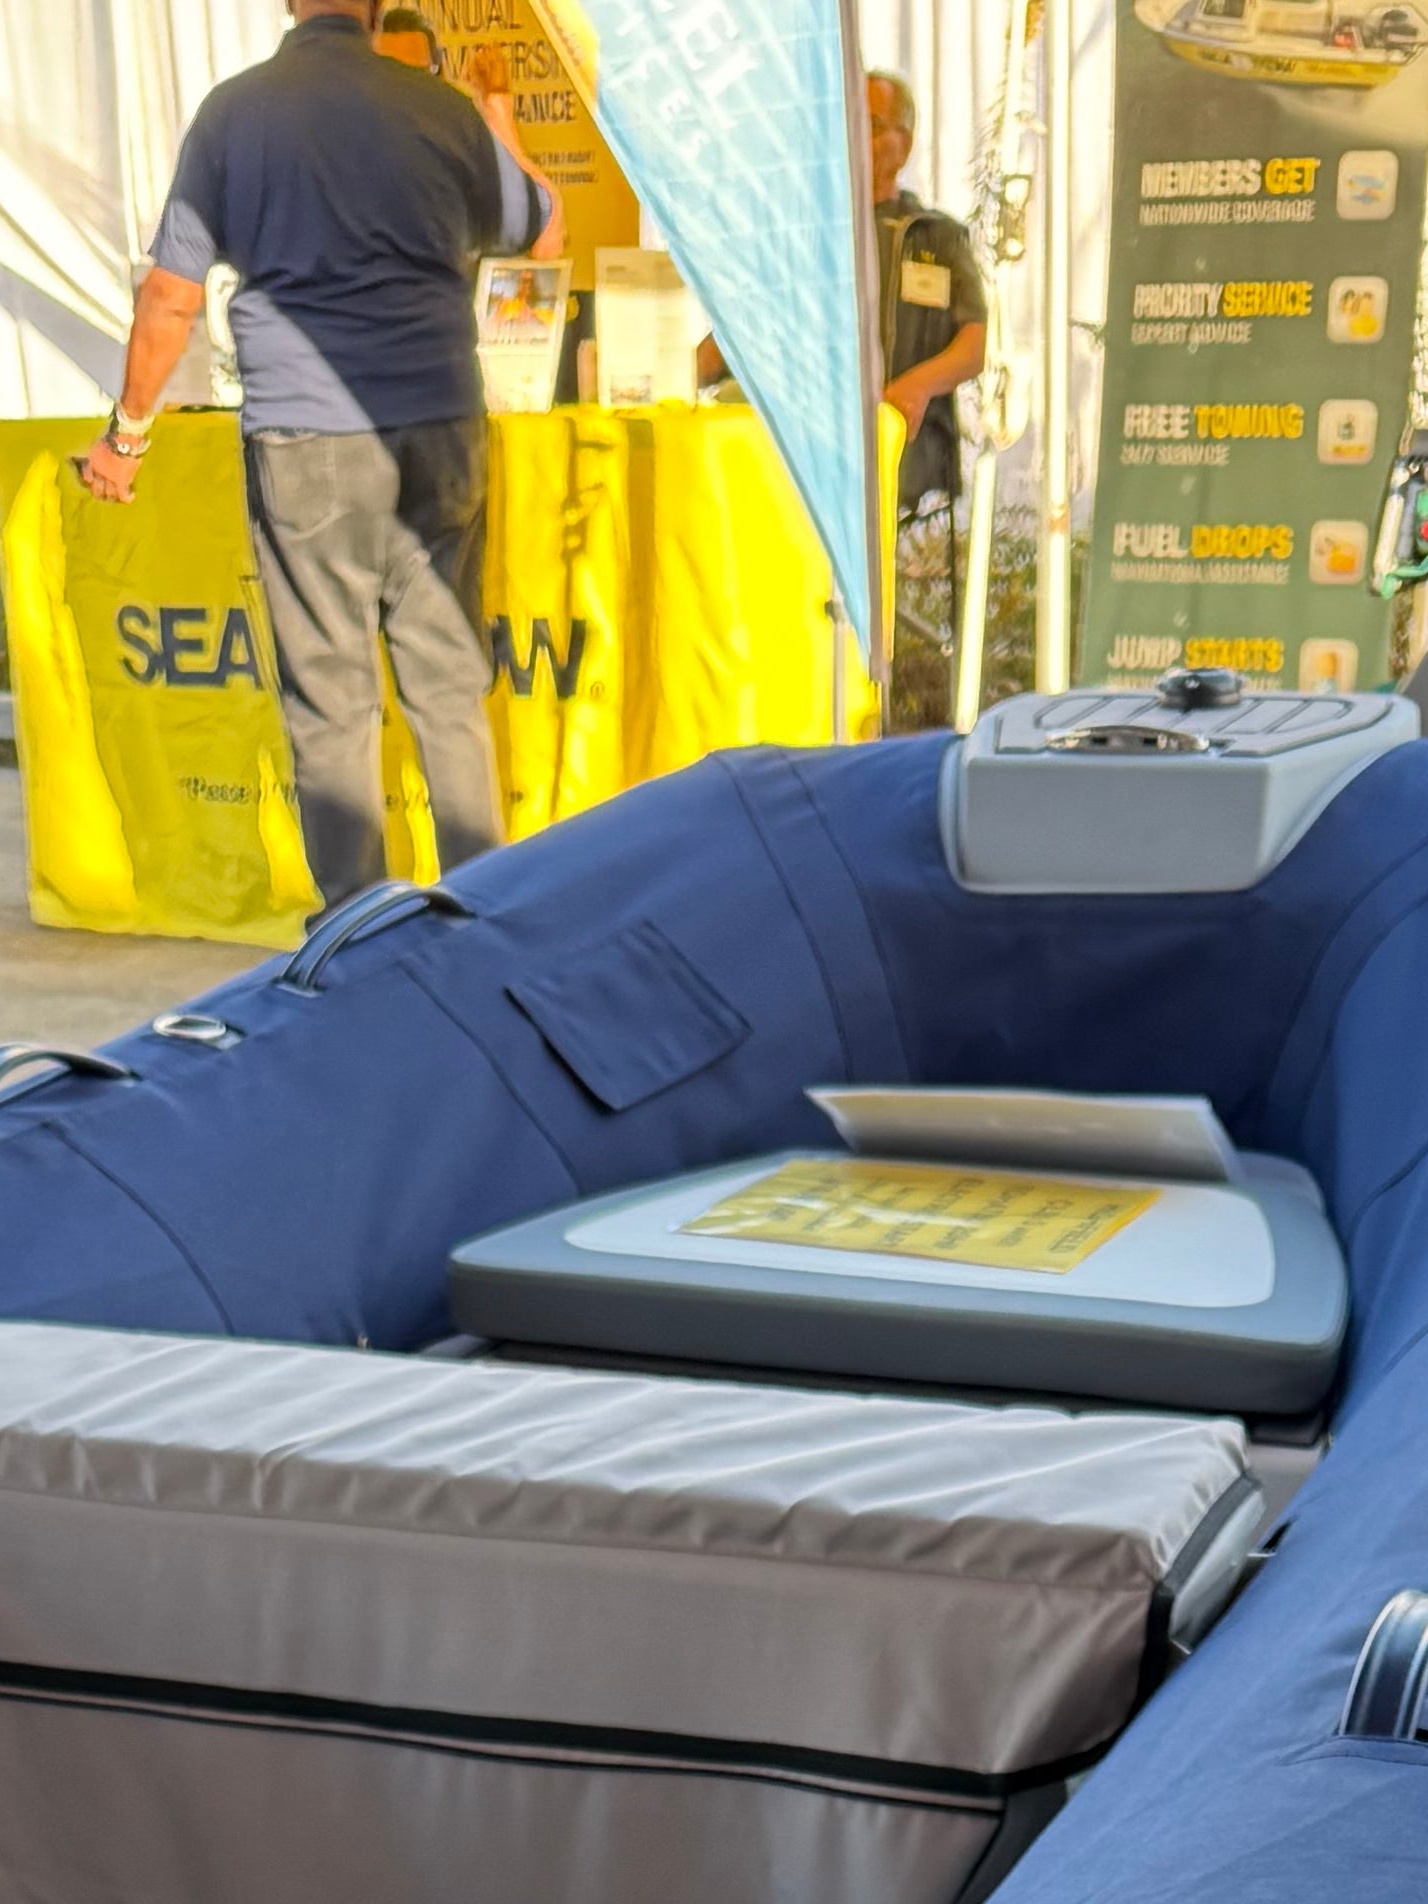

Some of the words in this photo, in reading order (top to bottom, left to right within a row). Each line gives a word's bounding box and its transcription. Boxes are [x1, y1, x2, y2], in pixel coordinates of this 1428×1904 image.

[1141, 158, 1262, 198] MEMBERS
[1264, 157, 1321, 194] GET
[1133, 283, 1223, 319] PRIORITY
[1222, 281, 1313, 317] SERVICE
[1124, 404, 1190, 439] FREE
[1194, 403, 1304, 440] TOWING
[1113, 522, 1189, 558] FUEL
[1191, 524, 1294, 560] DROPS
[117, 605, 263, 691] SEA
[1108, 634, 1182, 669] JUMP
[1185, 637, 1284, 672] STARTS
